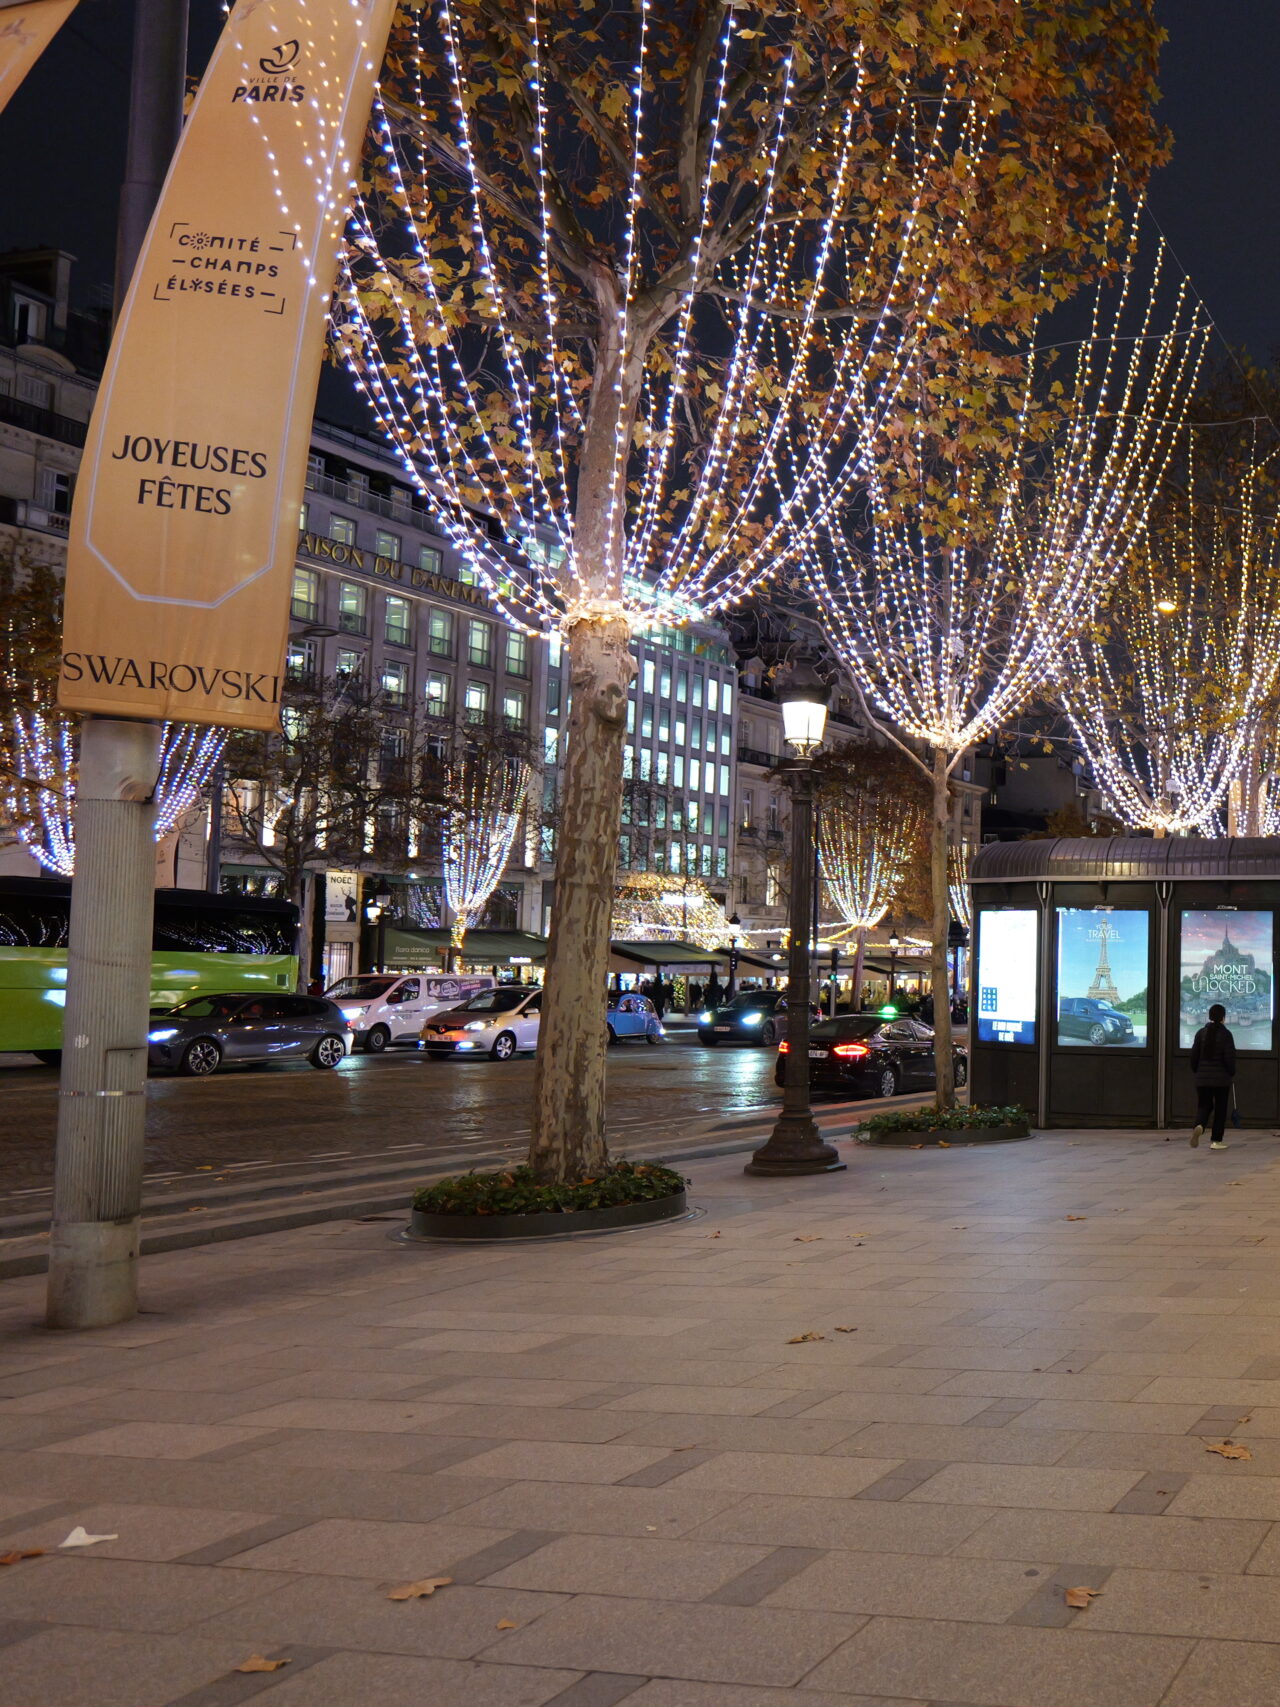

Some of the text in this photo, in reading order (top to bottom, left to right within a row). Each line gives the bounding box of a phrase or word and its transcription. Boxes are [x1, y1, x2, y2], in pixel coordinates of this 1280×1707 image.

[231, 85, 305, 103] PARIS
[190, 256, 278, 278] CHAMPS
[167, 274, 255, 298] ÉLYSÉES
[112, 434, 267, 478] JOYEUSES
[137, 475, 231, 515] FÊTES
[297, 533, 364, 568] AISON
[374, 556, 403, 581] DU
[63, 652, 280, 704] SWAROVSKI
[1088, 930, 1120, 938] TRAVEL
[1213, 965, 1248, 974] MONT
